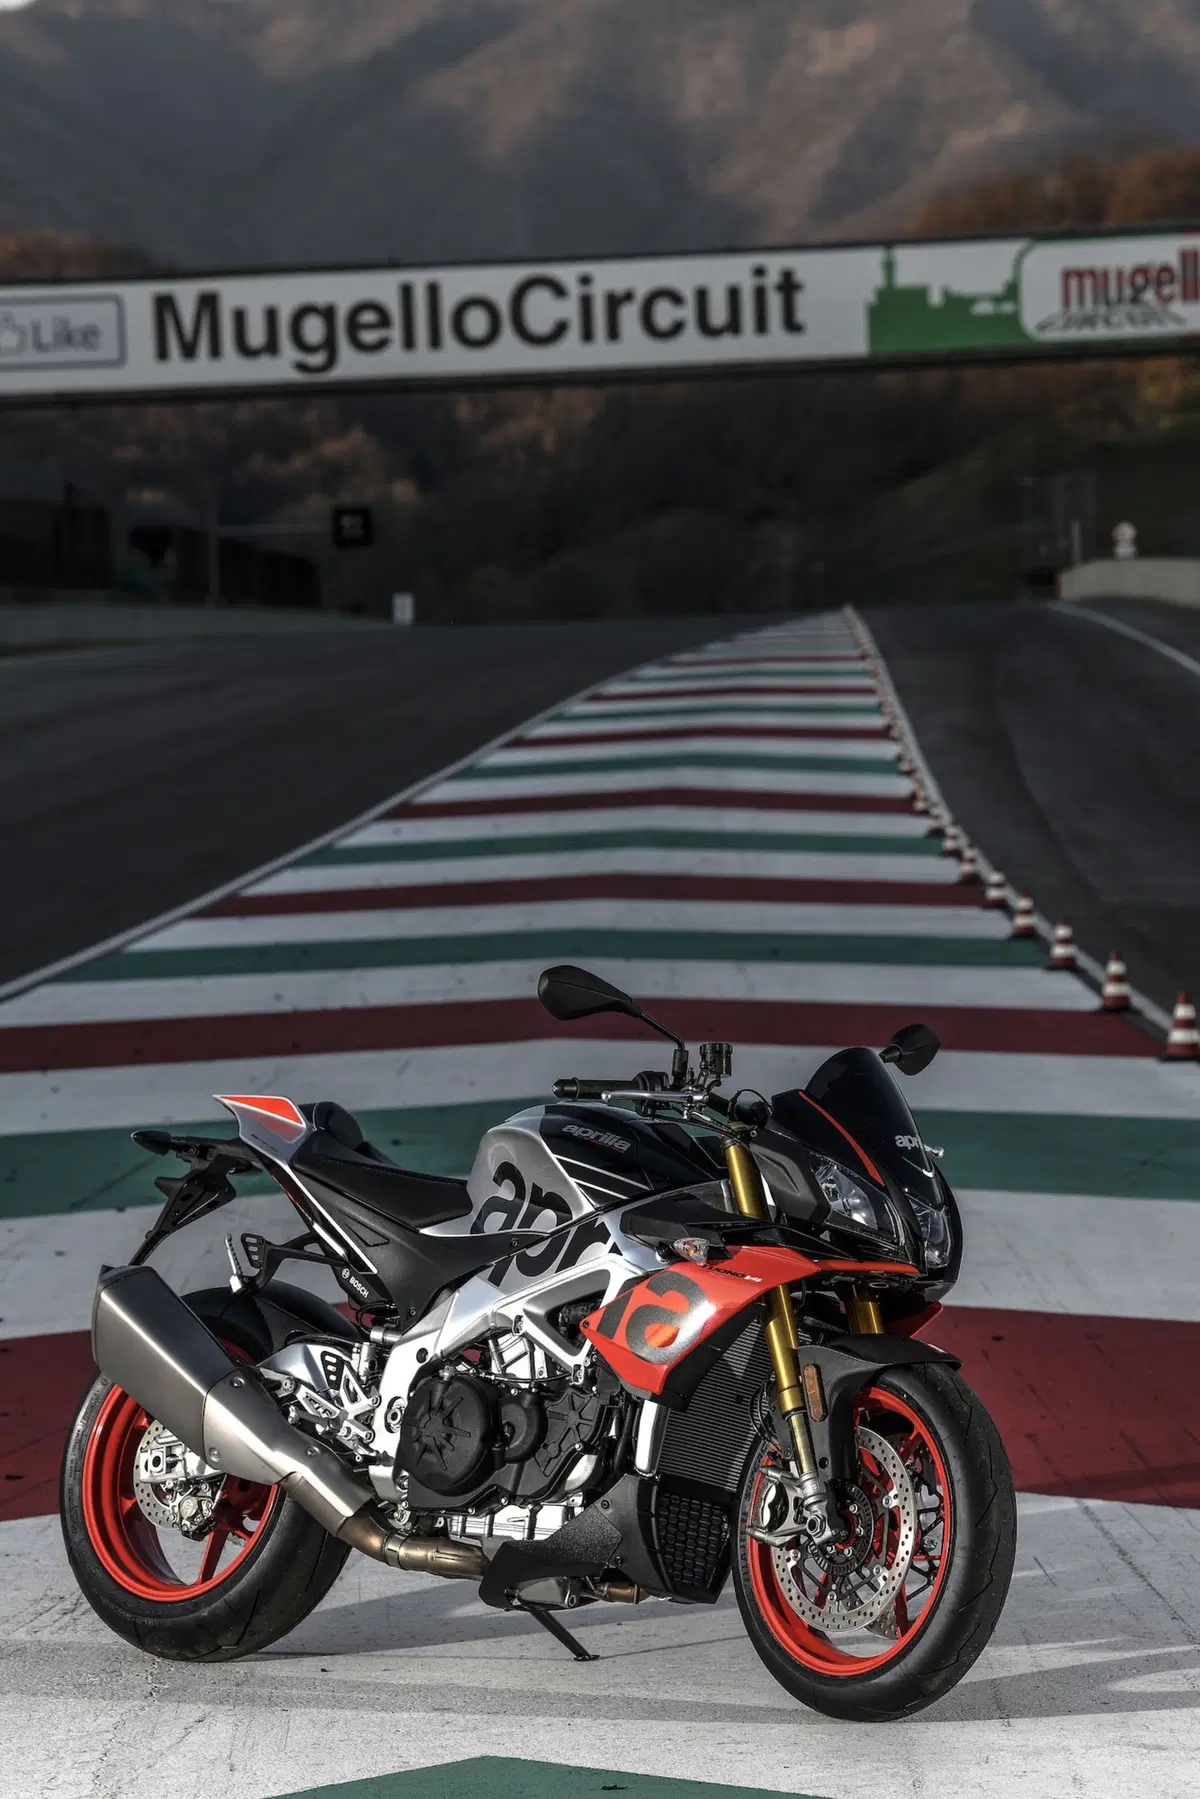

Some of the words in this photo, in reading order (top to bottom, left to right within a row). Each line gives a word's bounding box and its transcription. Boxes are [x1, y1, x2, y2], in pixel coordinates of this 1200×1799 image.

[31, 314, 101, 352] Like
[153, 265, 806, 374] MugelloCircuit
[562, 1124, 631, 1151] aprilia
[349, 1275, 369, 1298] BOSCH
